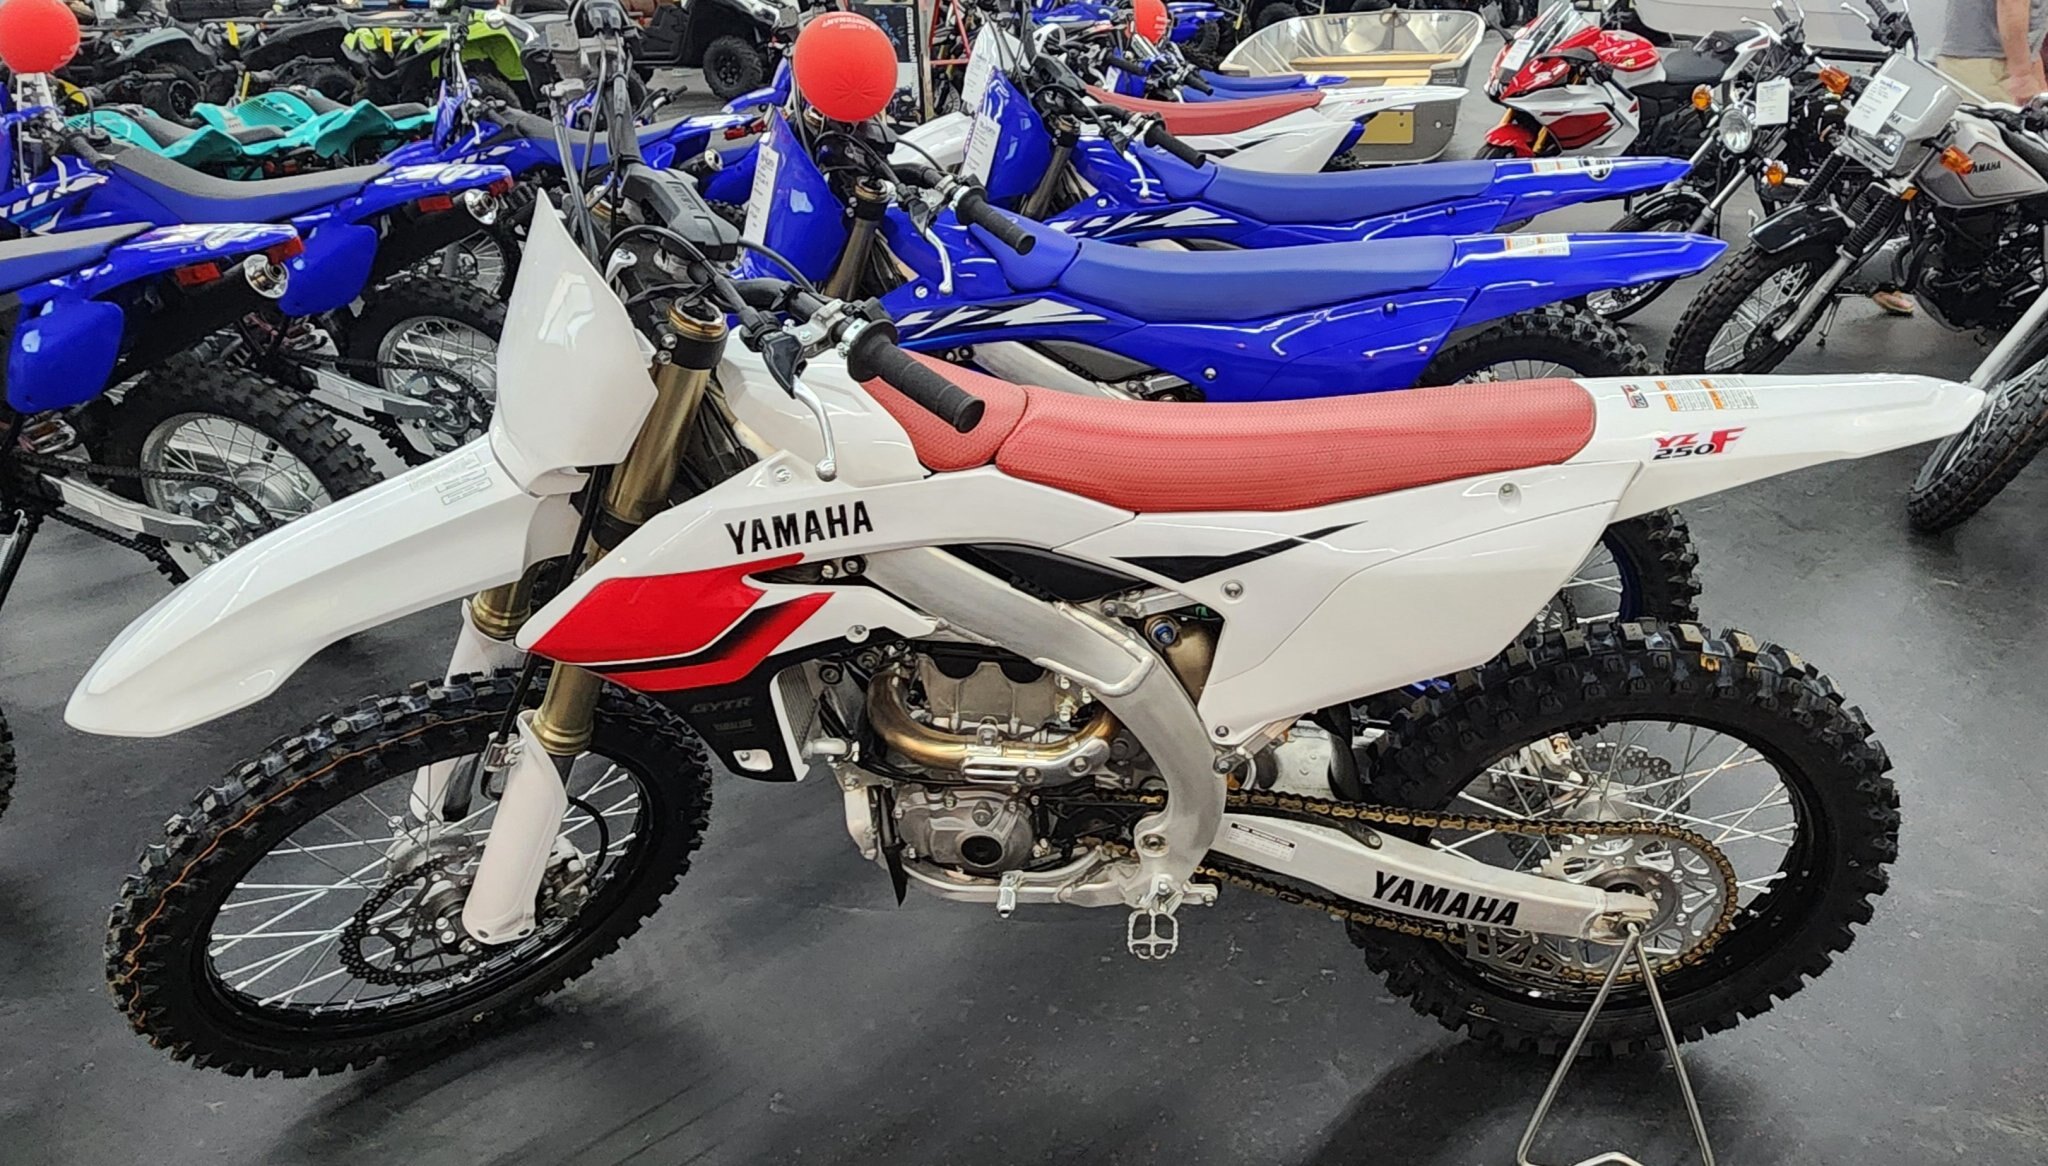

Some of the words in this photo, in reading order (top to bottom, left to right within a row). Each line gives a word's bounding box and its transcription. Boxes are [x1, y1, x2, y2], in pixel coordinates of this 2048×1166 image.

[1973, 161, 2001, 174] AMAHA
[1655, 433, 1699, 448] YZ
[725, 500, 874, 555] YAMAHA
[1372, 870, 1520, 926] YAMAHA
